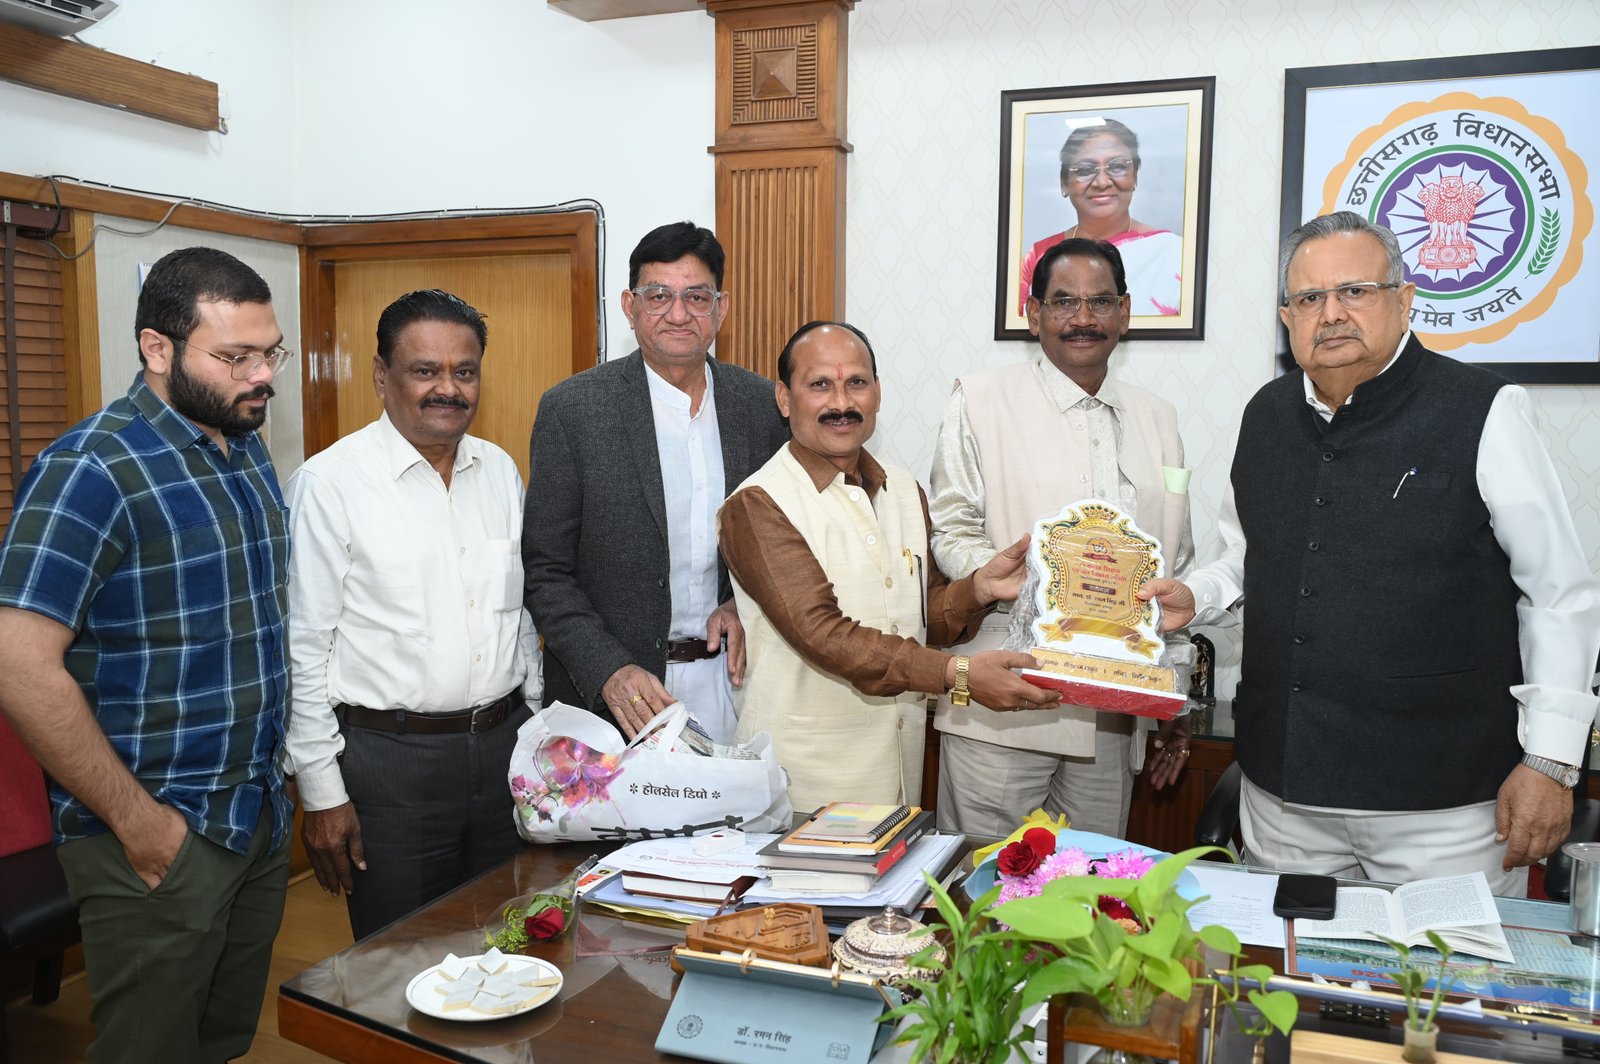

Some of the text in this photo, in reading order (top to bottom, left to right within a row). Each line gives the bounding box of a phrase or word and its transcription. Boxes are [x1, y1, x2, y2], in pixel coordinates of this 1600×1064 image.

[1346, 112, 1560, 206] छत्तीसगढ़ विधानसभा
[1464, 286, 1523, 321] जयते
[642, 782, 708, 799] होलसेल डिपो
[737, 1026, 792, 1044] डॉ. रमन सिंह
